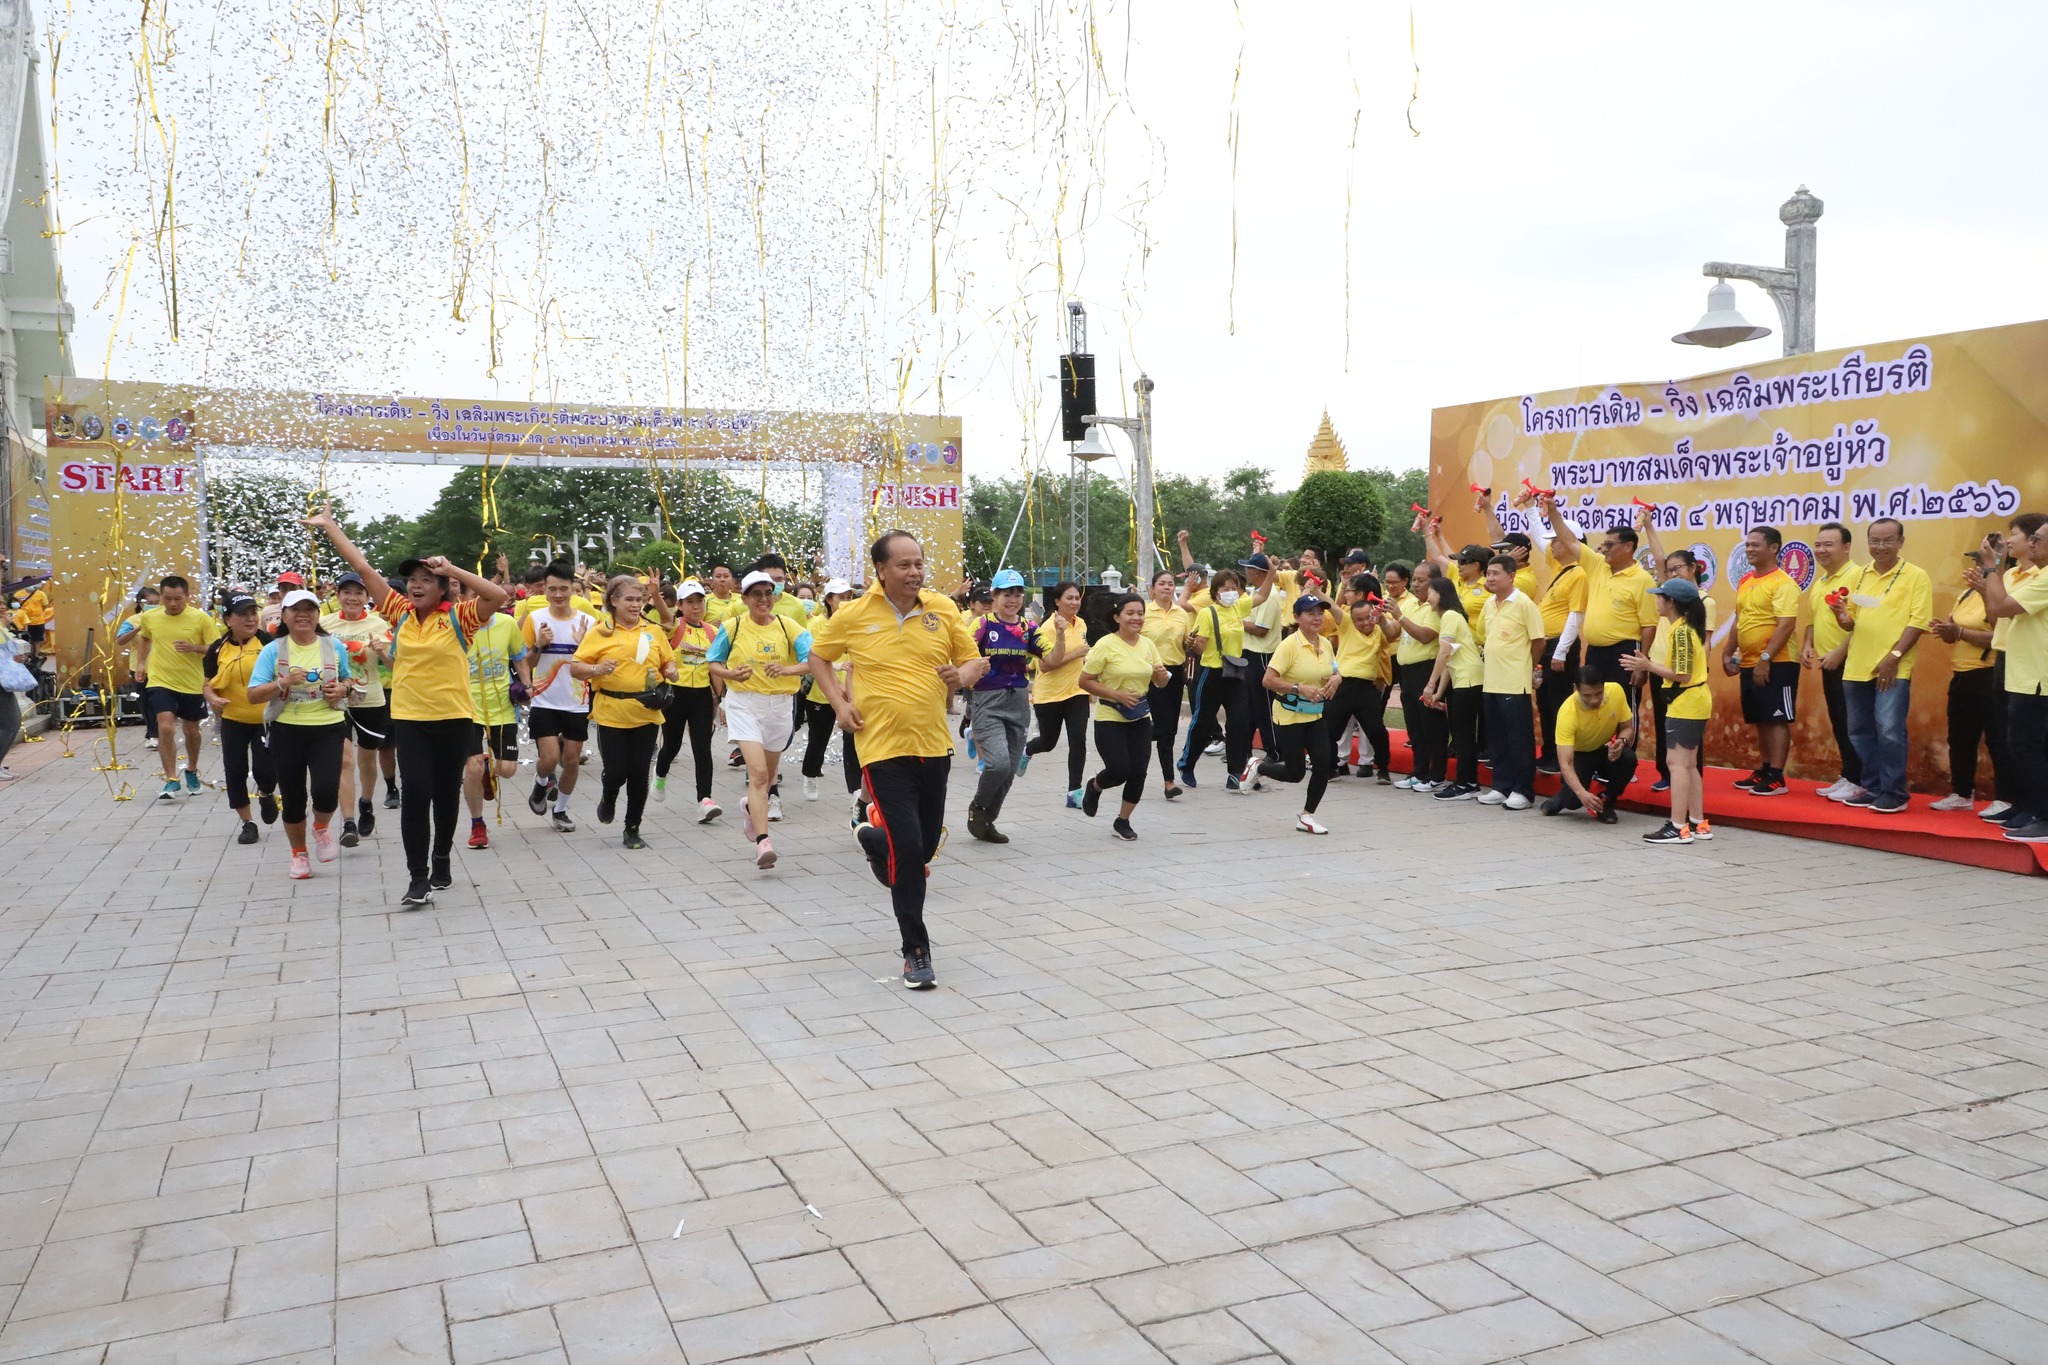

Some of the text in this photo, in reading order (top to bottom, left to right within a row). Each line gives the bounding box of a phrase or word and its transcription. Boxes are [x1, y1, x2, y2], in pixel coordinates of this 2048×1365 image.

[1522, 392, 1640, 433] โครงการเดิน
[1666, 380, 1698, 417] วิ่ง
[1706, 349, 1928, 411] เฉลิมพระเกียรติ
[63, 464, 190, 492] START
[1551, 423, 1885, 486] พระบาทสมเด็จพระเจ้าอยู่หัว
[1715, 495, 1841, 535] พฤษภาคม
[1852, 484, 2016, 518] พ.ศ.๒๕๖๖
